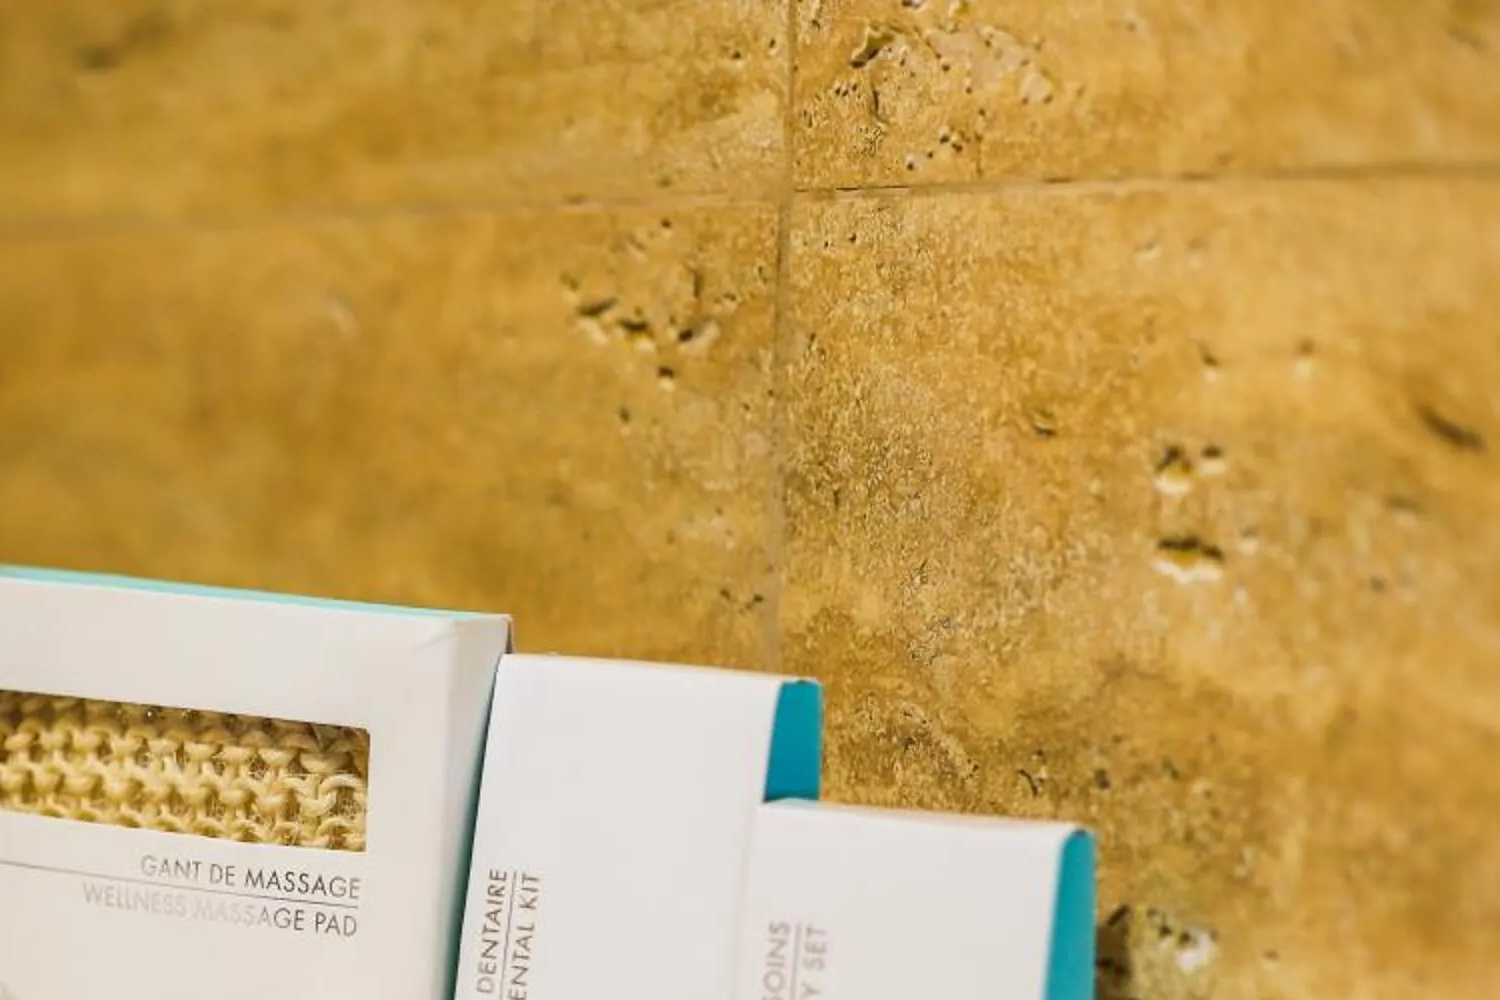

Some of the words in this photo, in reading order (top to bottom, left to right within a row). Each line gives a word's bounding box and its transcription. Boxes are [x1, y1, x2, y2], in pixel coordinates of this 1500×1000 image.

[141, 854, 202, 880] GANT
[210, 862, 236, 886] DE
[245, 868, 361, 900] MASSAGE
[520, 871, 541, 911] KIT
[83, 881, 187, 917] WELLNESS
[192, 896, 305, 932] MASSAGE
[315, 911, 358, 938] PAD
[476, 868, 508, 996] DENTAIRE
[803, 925, 828, 971] SET
